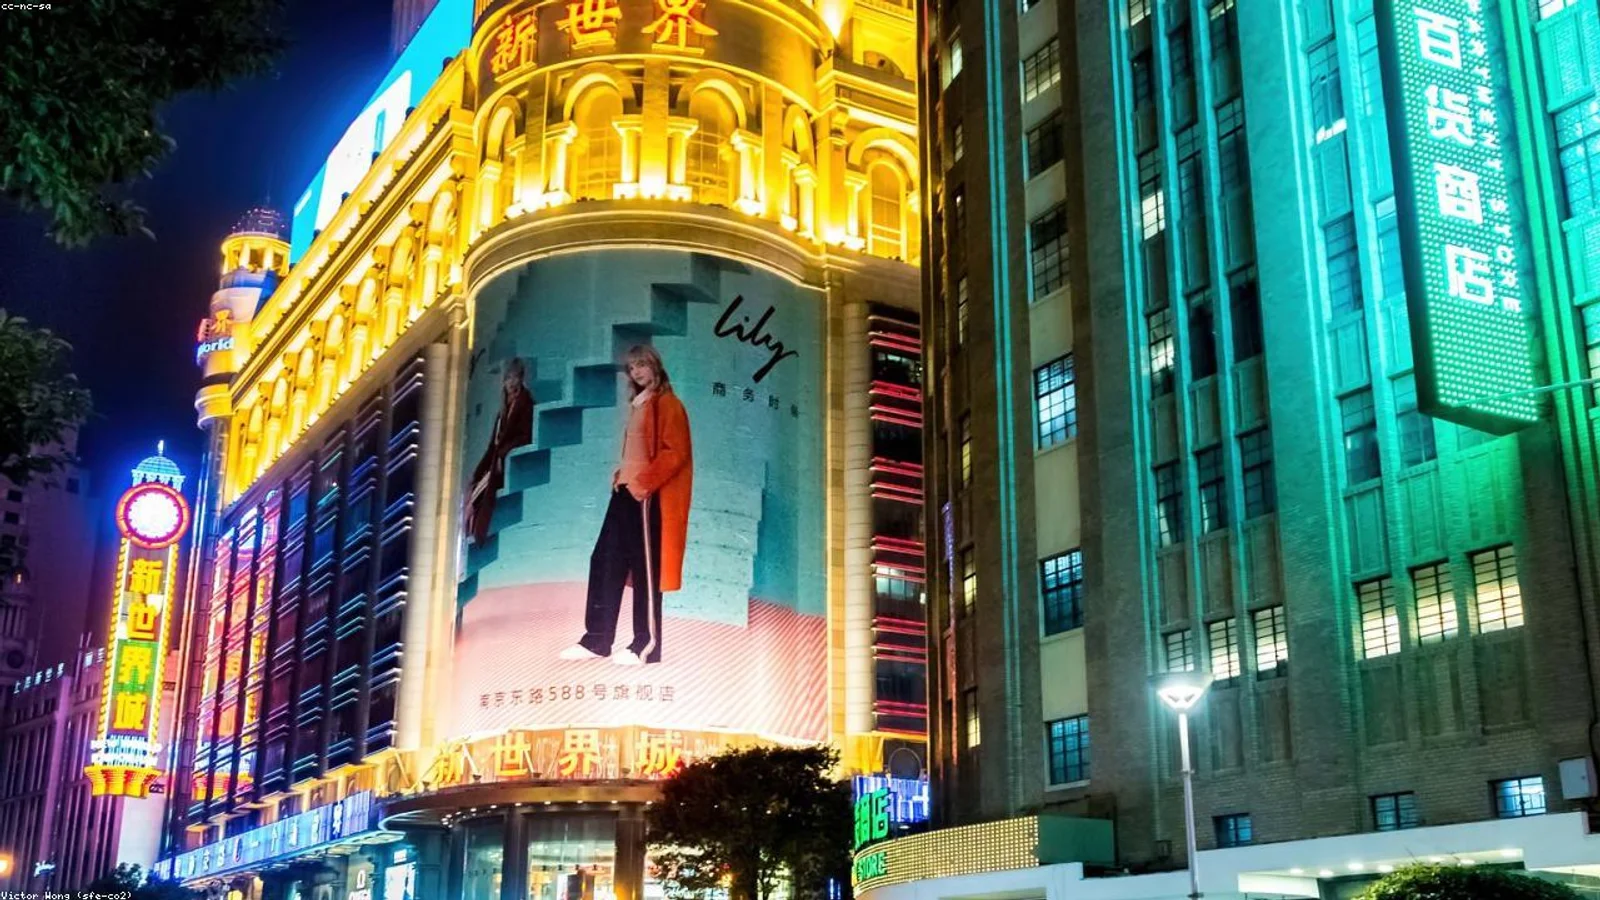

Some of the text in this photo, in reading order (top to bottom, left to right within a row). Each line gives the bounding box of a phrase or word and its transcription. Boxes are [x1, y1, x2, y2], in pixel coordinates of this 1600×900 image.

[491, 0, 719, 82] 新世界
[1412, 5, 1494, 306] 百货商店
[1489, 198, 1521, 314] STORE
[113, 558, 163, 730] 新世界城
[433, 729, 682, 784] 新世界城
